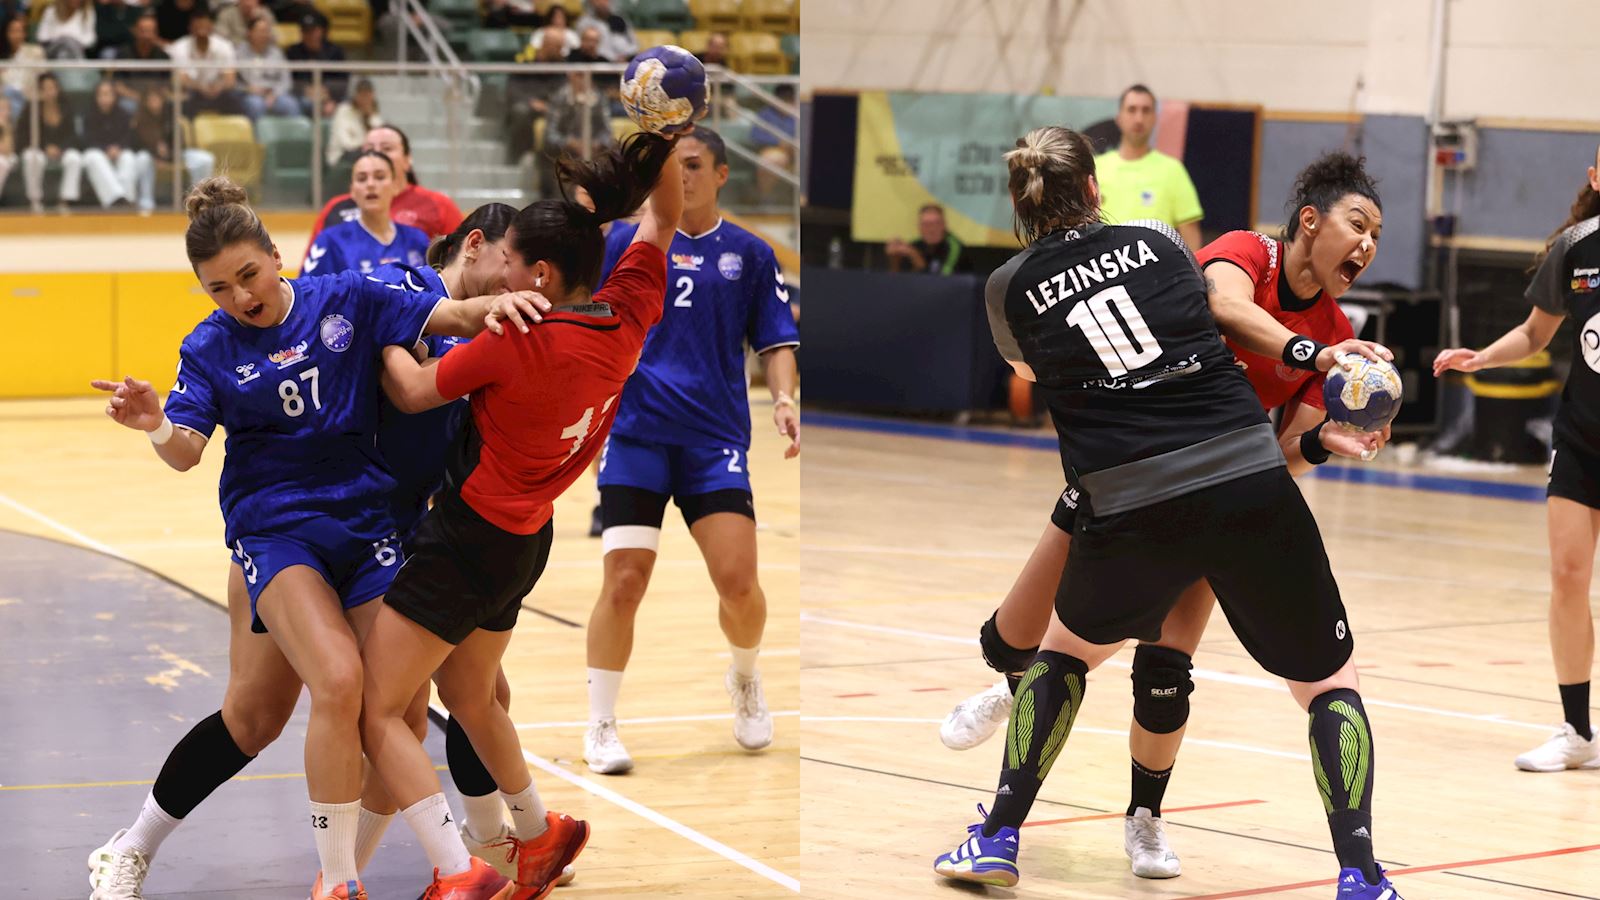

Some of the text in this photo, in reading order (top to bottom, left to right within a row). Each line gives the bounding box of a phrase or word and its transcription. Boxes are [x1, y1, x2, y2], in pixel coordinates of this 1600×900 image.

[1025, 239, 1160, 315] LEZINSKA
[674, 276, 694, 308] 2
[572, 304, 593, 312] NIKE
[1065, 284, 1163, 378] 10
[278, 366, 322, 417] 87
[722, 448, 743, 473] 2
[1150, 686, 1178, 696] SELECT
[311, 814, 328, 829] 23
